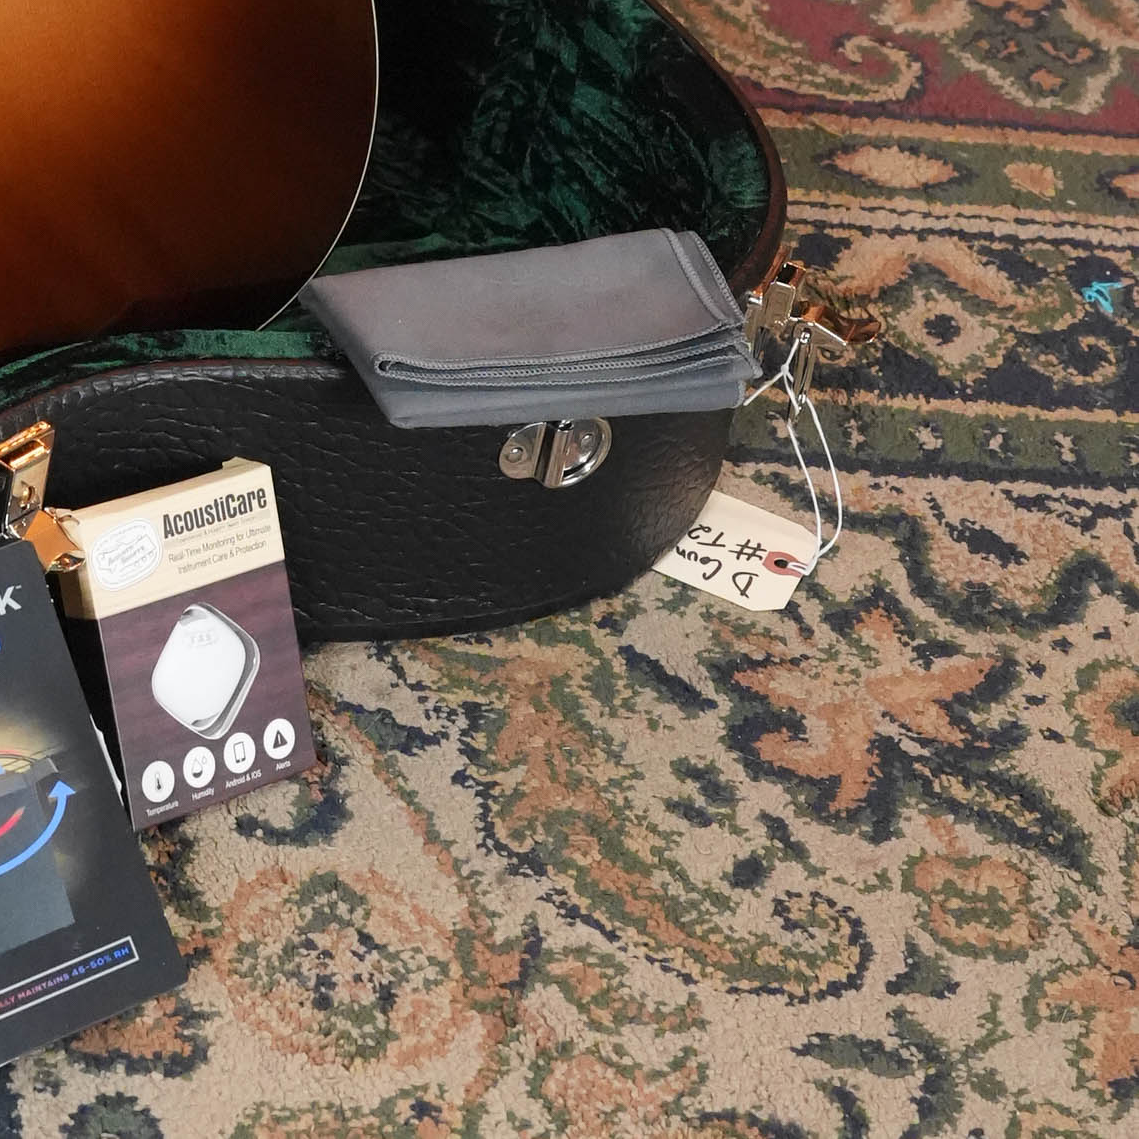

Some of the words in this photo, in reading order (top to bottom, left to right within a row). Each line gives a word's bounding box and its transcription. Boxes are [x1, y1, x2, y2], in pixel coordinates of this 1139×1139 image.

[162, 488, 267, 540] AcoustiCare
[202, 536, 235, 552] Monitoring
[212, 552, 228, 563] Care
[236, 540, 267, 557] Protection
[16, 973, 70, 1001] MAINTAINS
[113, 946, 130, 960] RH
